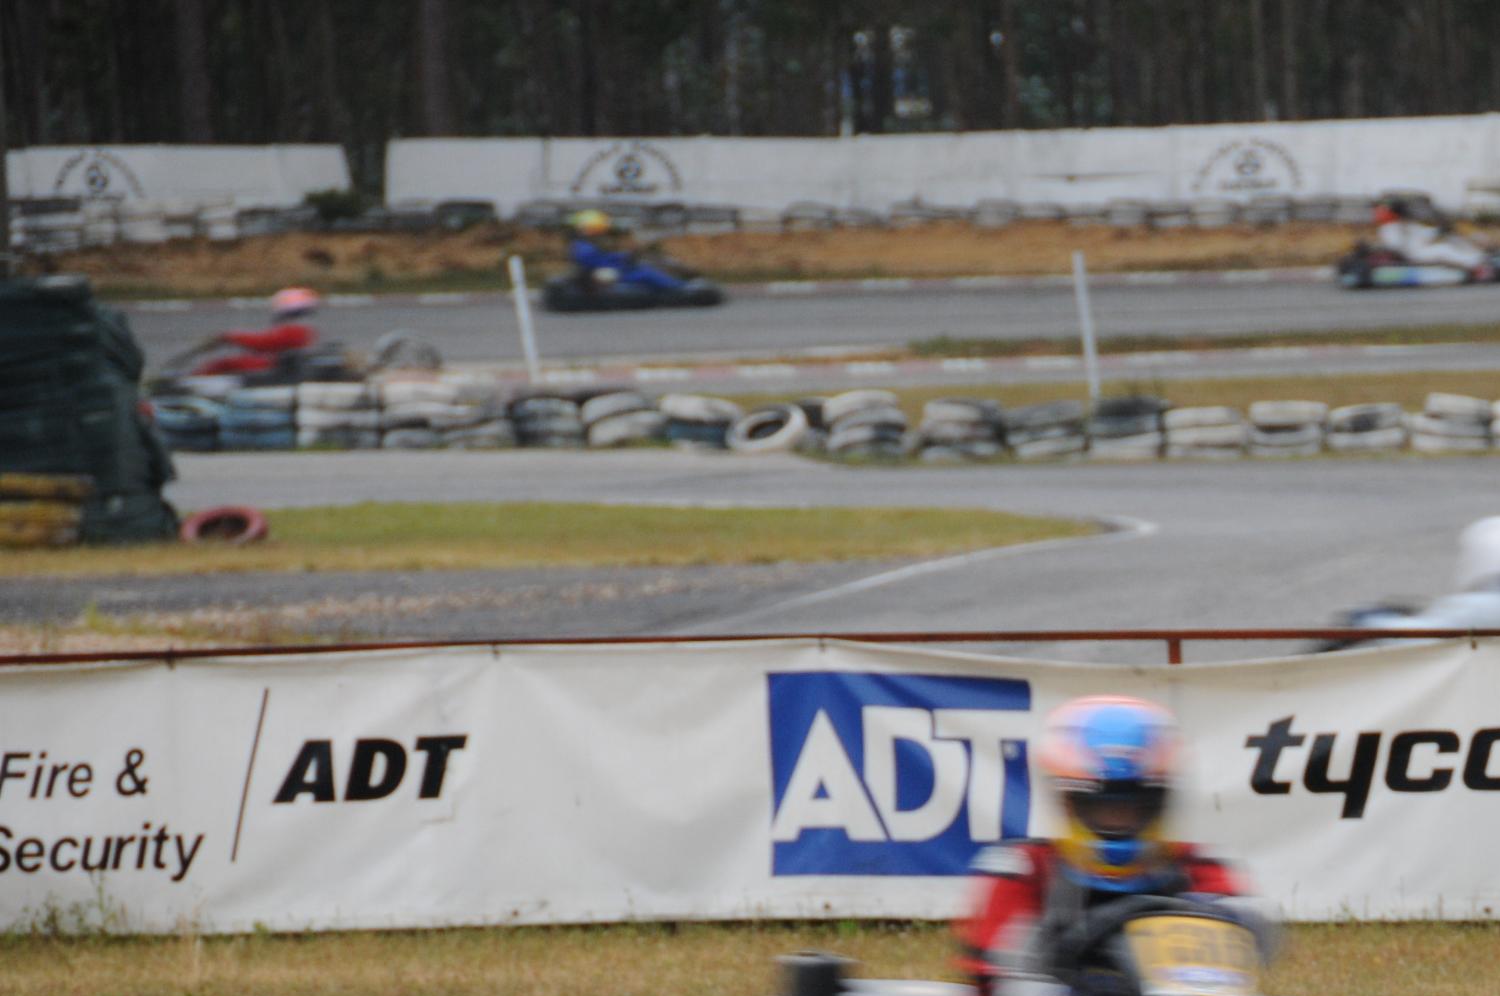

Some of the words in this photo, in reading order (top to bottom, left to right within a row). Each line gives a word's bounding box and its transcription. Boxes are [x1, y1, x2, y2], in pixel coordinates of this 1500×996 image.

[0, 751, 94, 799] Fire
[115, 748, 149, 797] &
[273, 734, 468, 803] ADT
[772, 705, 1030, 842] ADT
[0, 822, 205, 881] Security
